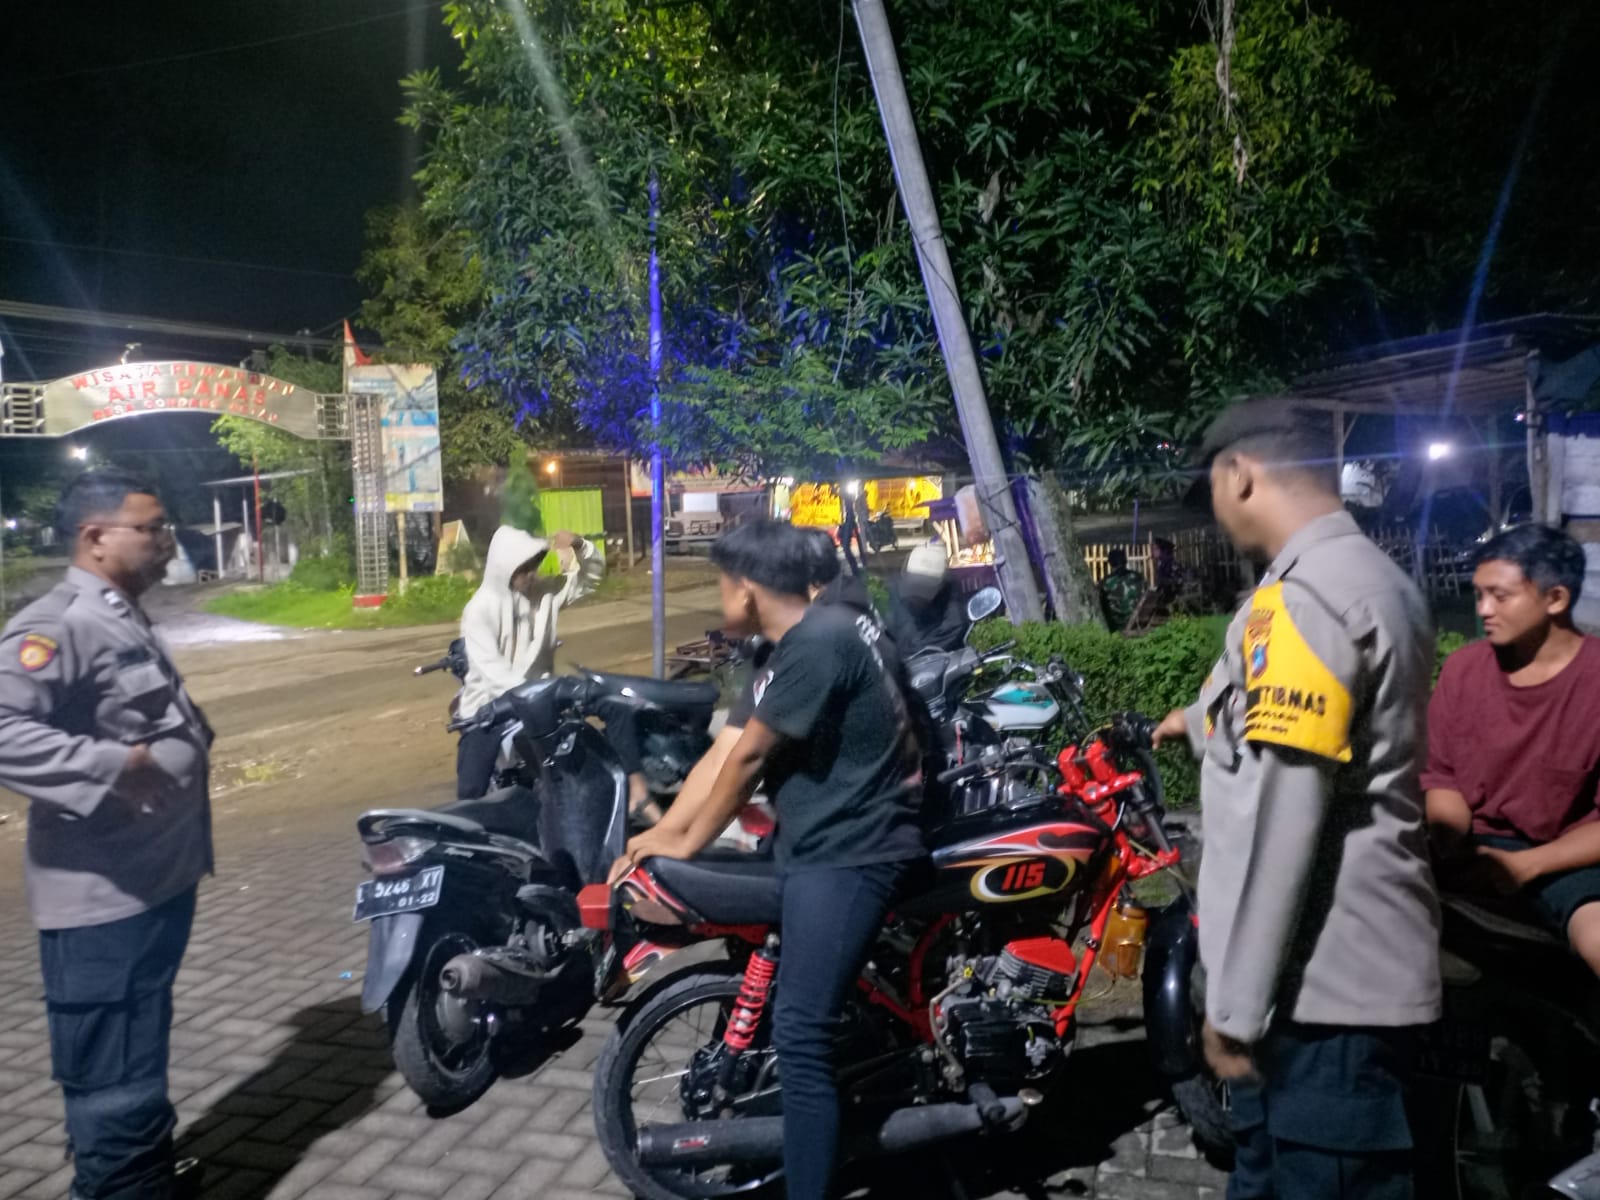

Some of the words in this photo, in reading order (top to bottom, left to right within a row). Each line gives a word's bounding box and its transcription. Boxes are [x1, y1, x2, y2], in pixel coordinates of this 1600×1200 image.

[71, 365, 161, 389] WISATA
[108, 381, 157, 402] AIR
[176, 379, 266, 405] PANAS
[1002, 862, 1046, 891] 115
